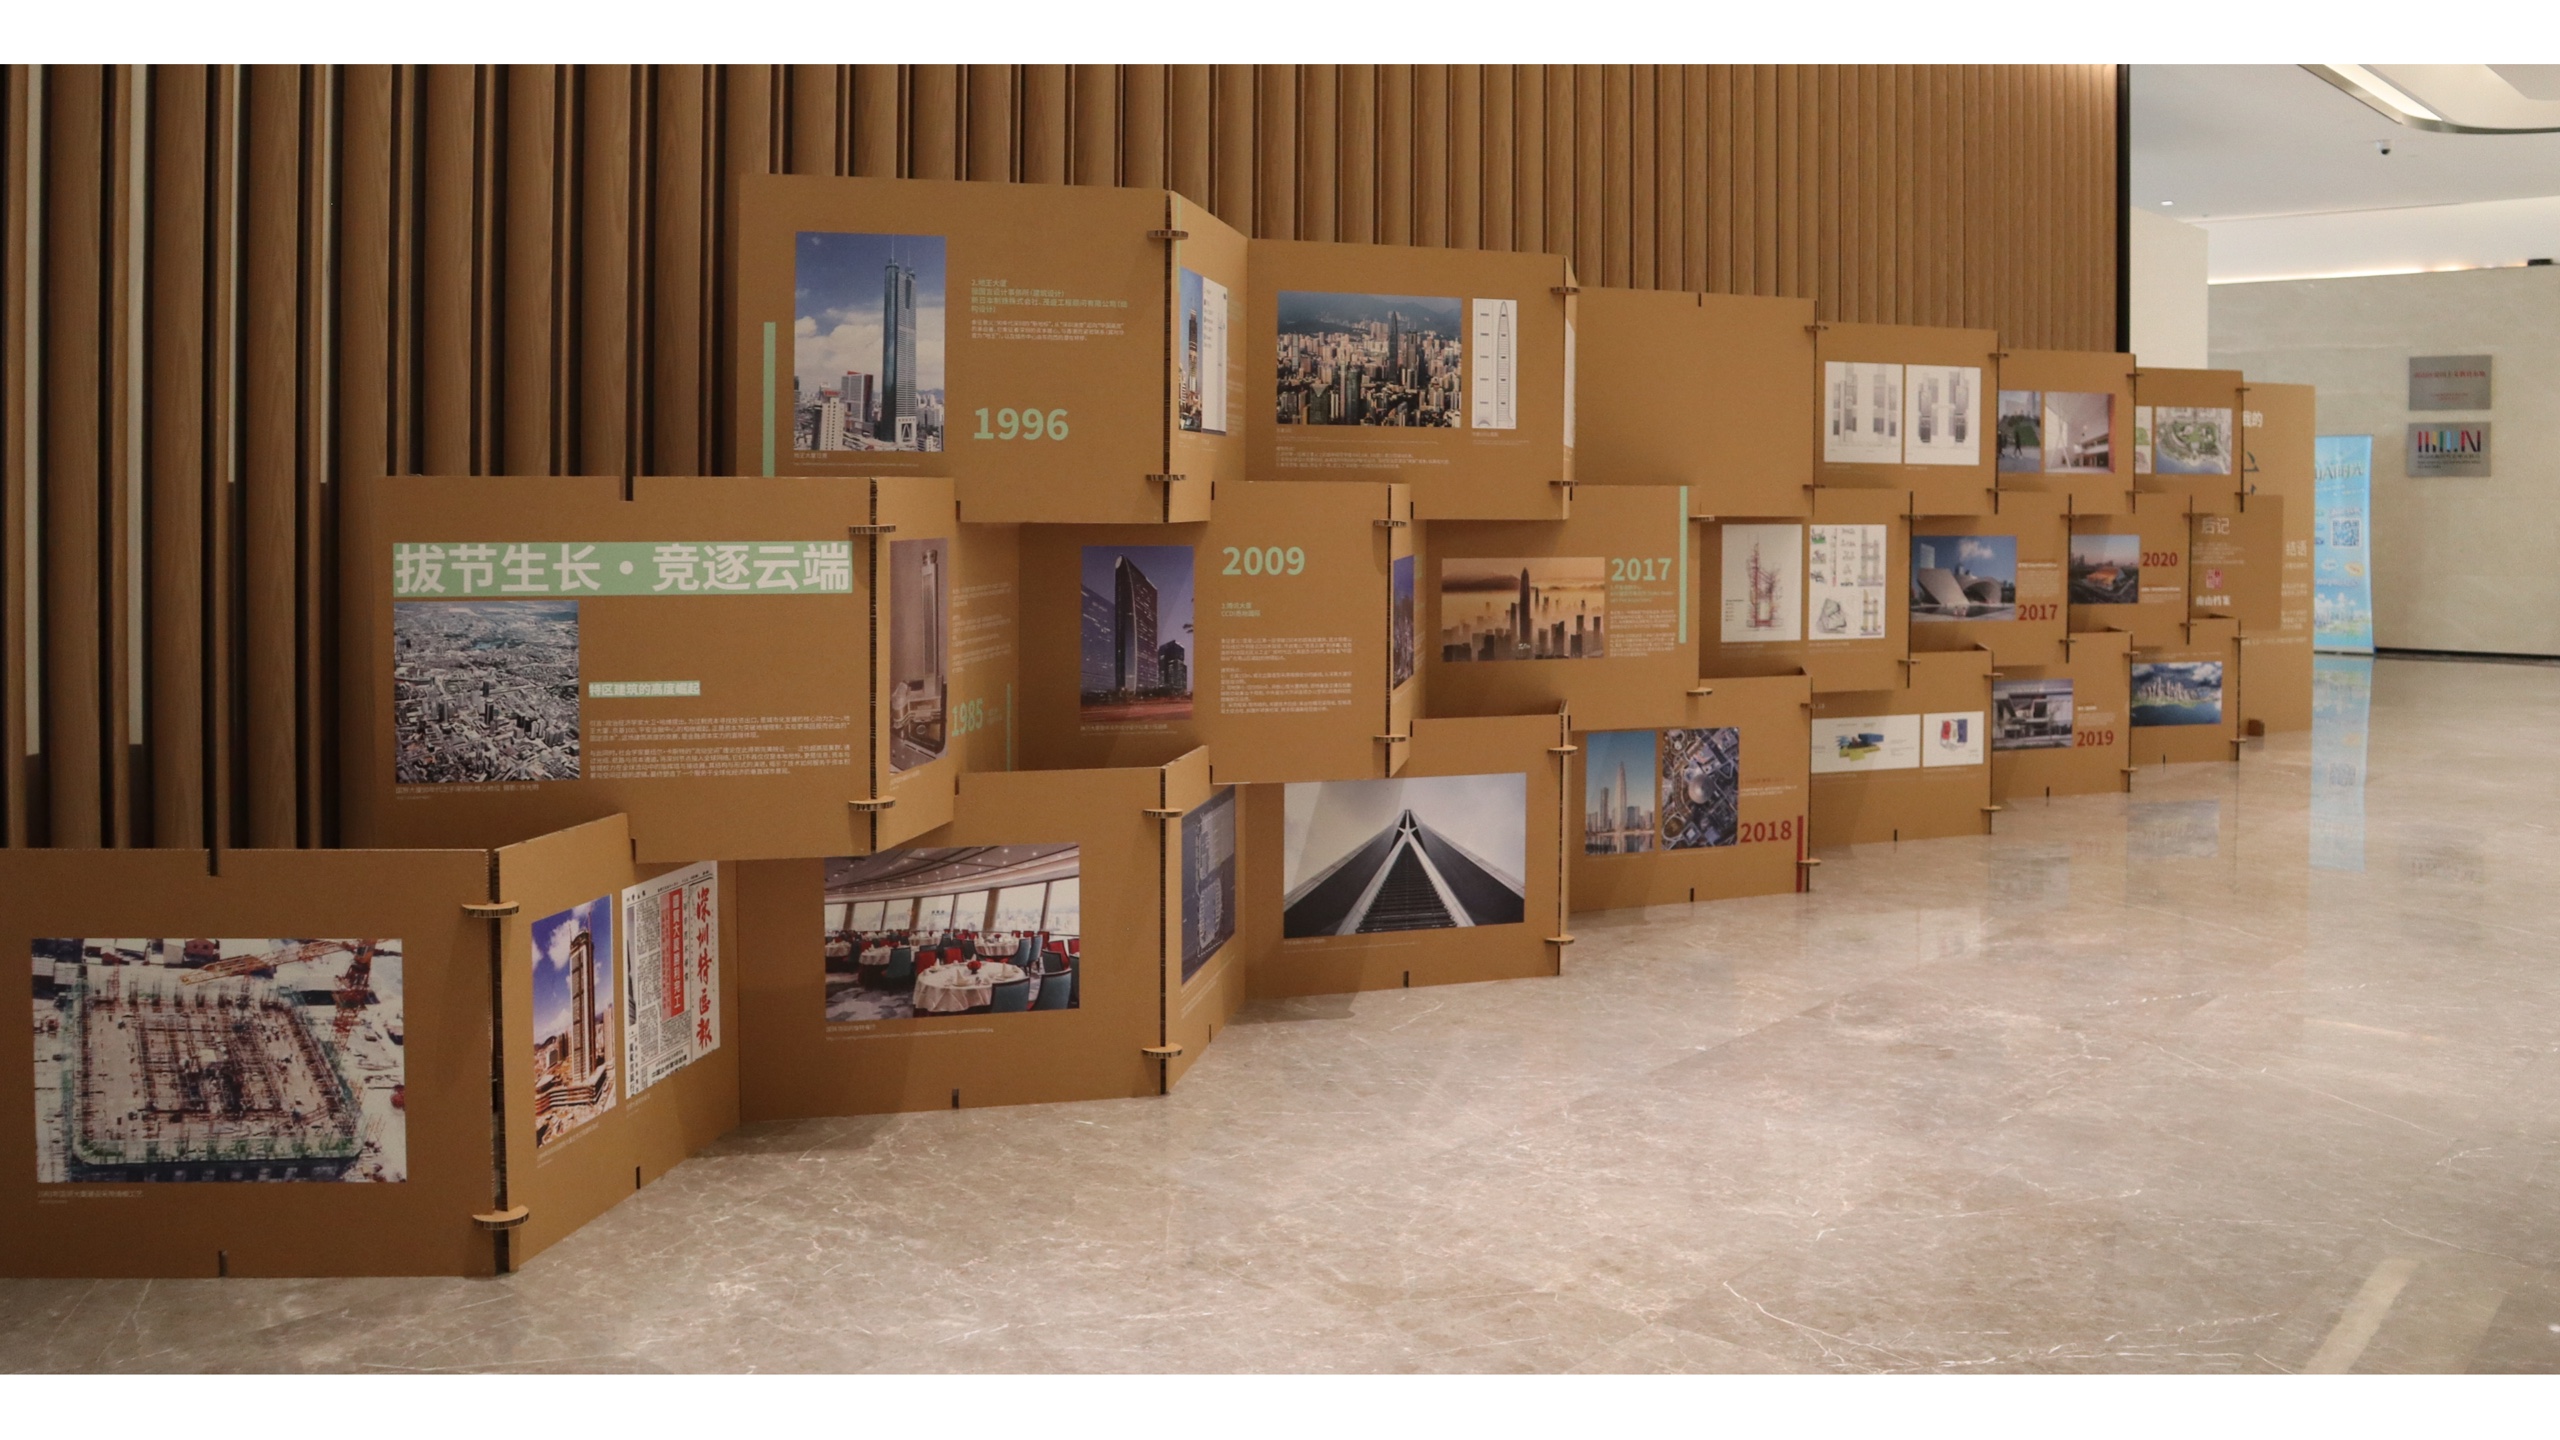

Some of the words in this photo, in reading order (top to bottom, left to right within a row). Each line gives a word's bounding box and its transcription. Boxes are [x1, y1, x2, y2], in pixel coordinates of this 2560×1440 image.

[973, 407, 1069, 441] 1996
[1222, 546, 1305, 576] 2009
[1611, 557, 1672, 582] 2017
[2142, 552, 2179, 567] 2020
[2018, 604, 2058, 621] 2017
[951, 698, 985, 738] 1985
[2077, 730, 2115, 747] 2019
[1740, 820, 1793, 844] 2018
